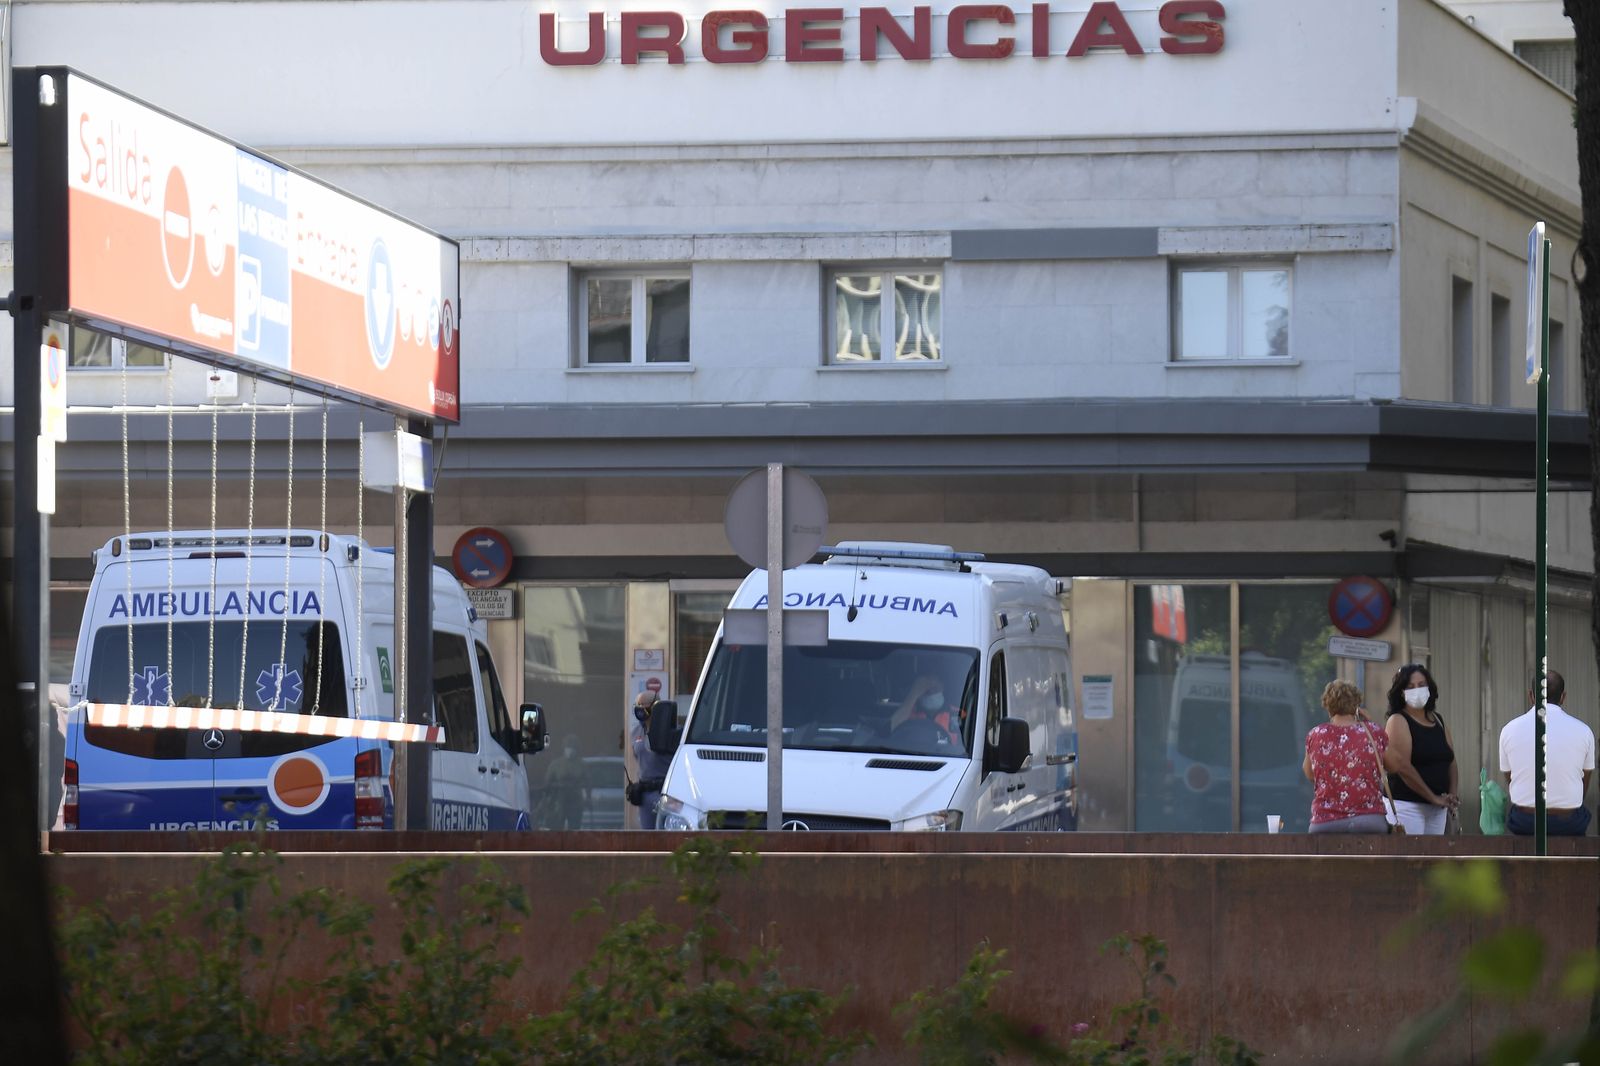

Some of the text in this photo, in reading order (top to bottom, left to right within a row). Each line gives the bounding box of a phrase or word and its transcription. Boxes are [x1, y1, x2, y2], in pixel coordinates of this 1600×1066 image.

[538, 0, 1226, 66] URGENCIAS
[79, 111, 152, 206] Salida
[108, 590, 323, 618] AMBULANCIA
